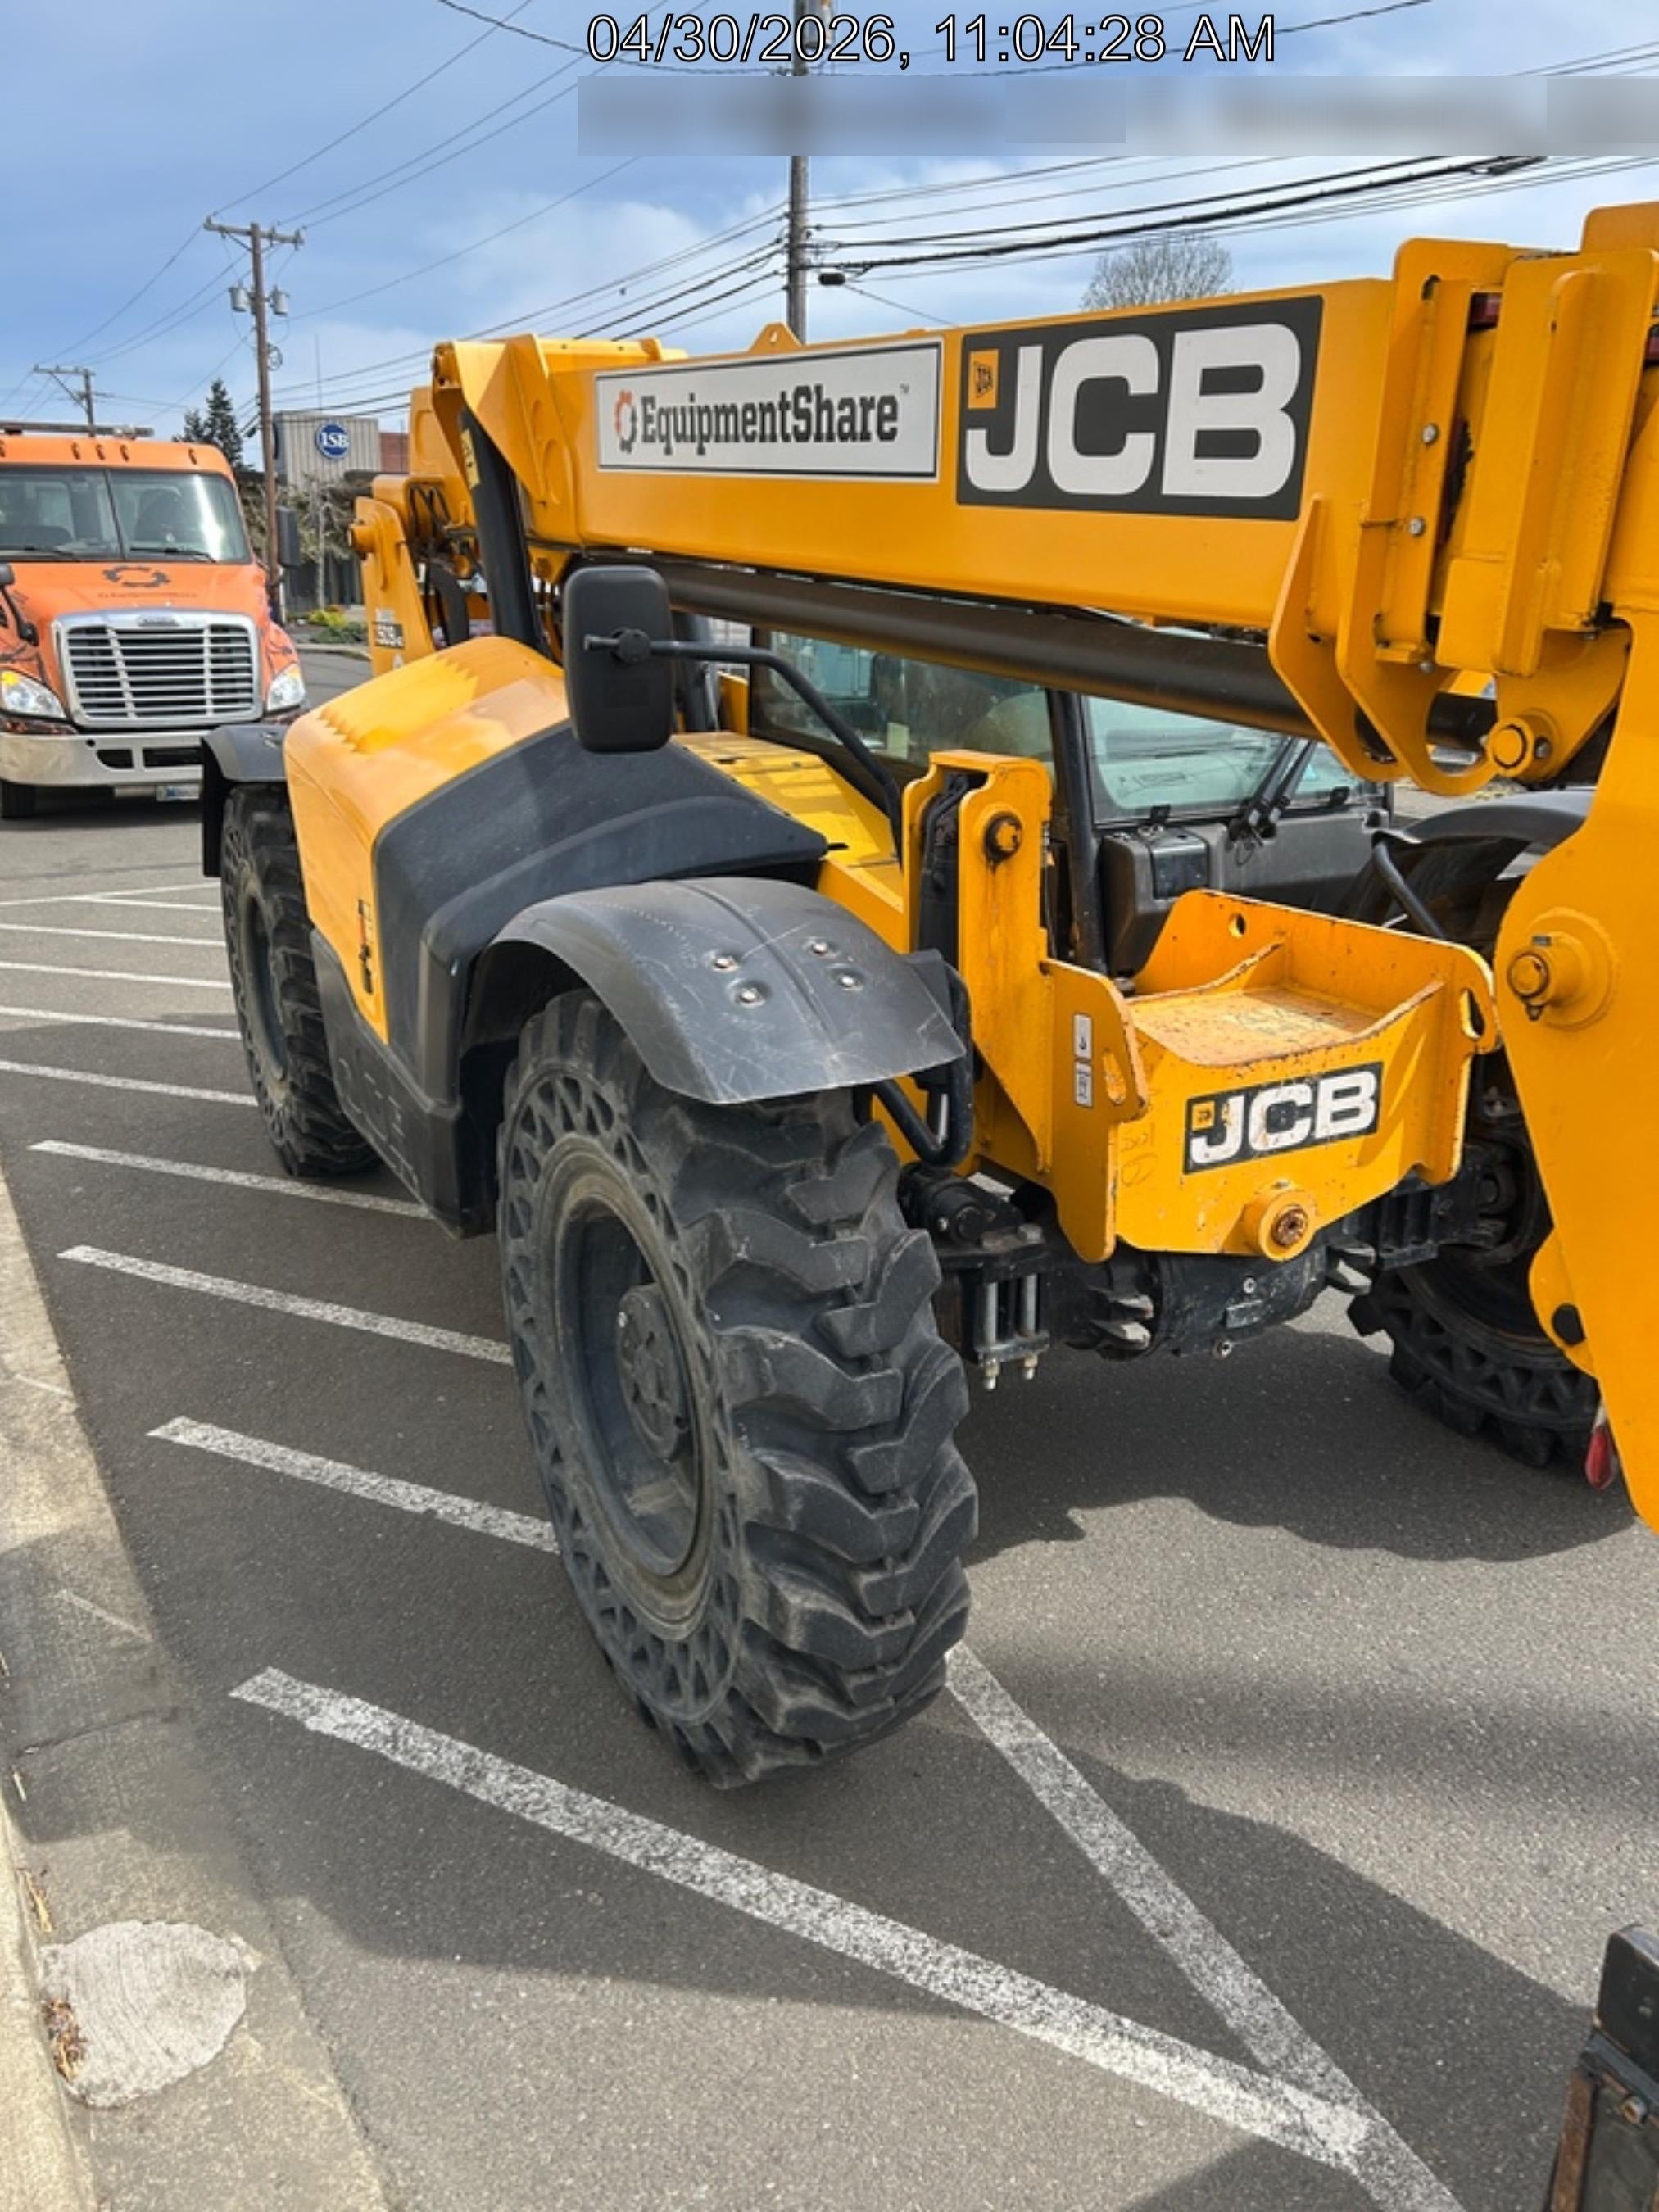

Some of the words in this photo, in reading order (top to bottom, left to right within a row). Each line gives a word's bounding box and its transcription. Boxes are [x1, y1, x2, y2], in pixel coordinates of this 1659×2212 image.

[641, 384, 898, 456] EquipmentShare
[965, 323, 1301, 497] JCB
[1190, 1071, 1377, 1164] JCB
